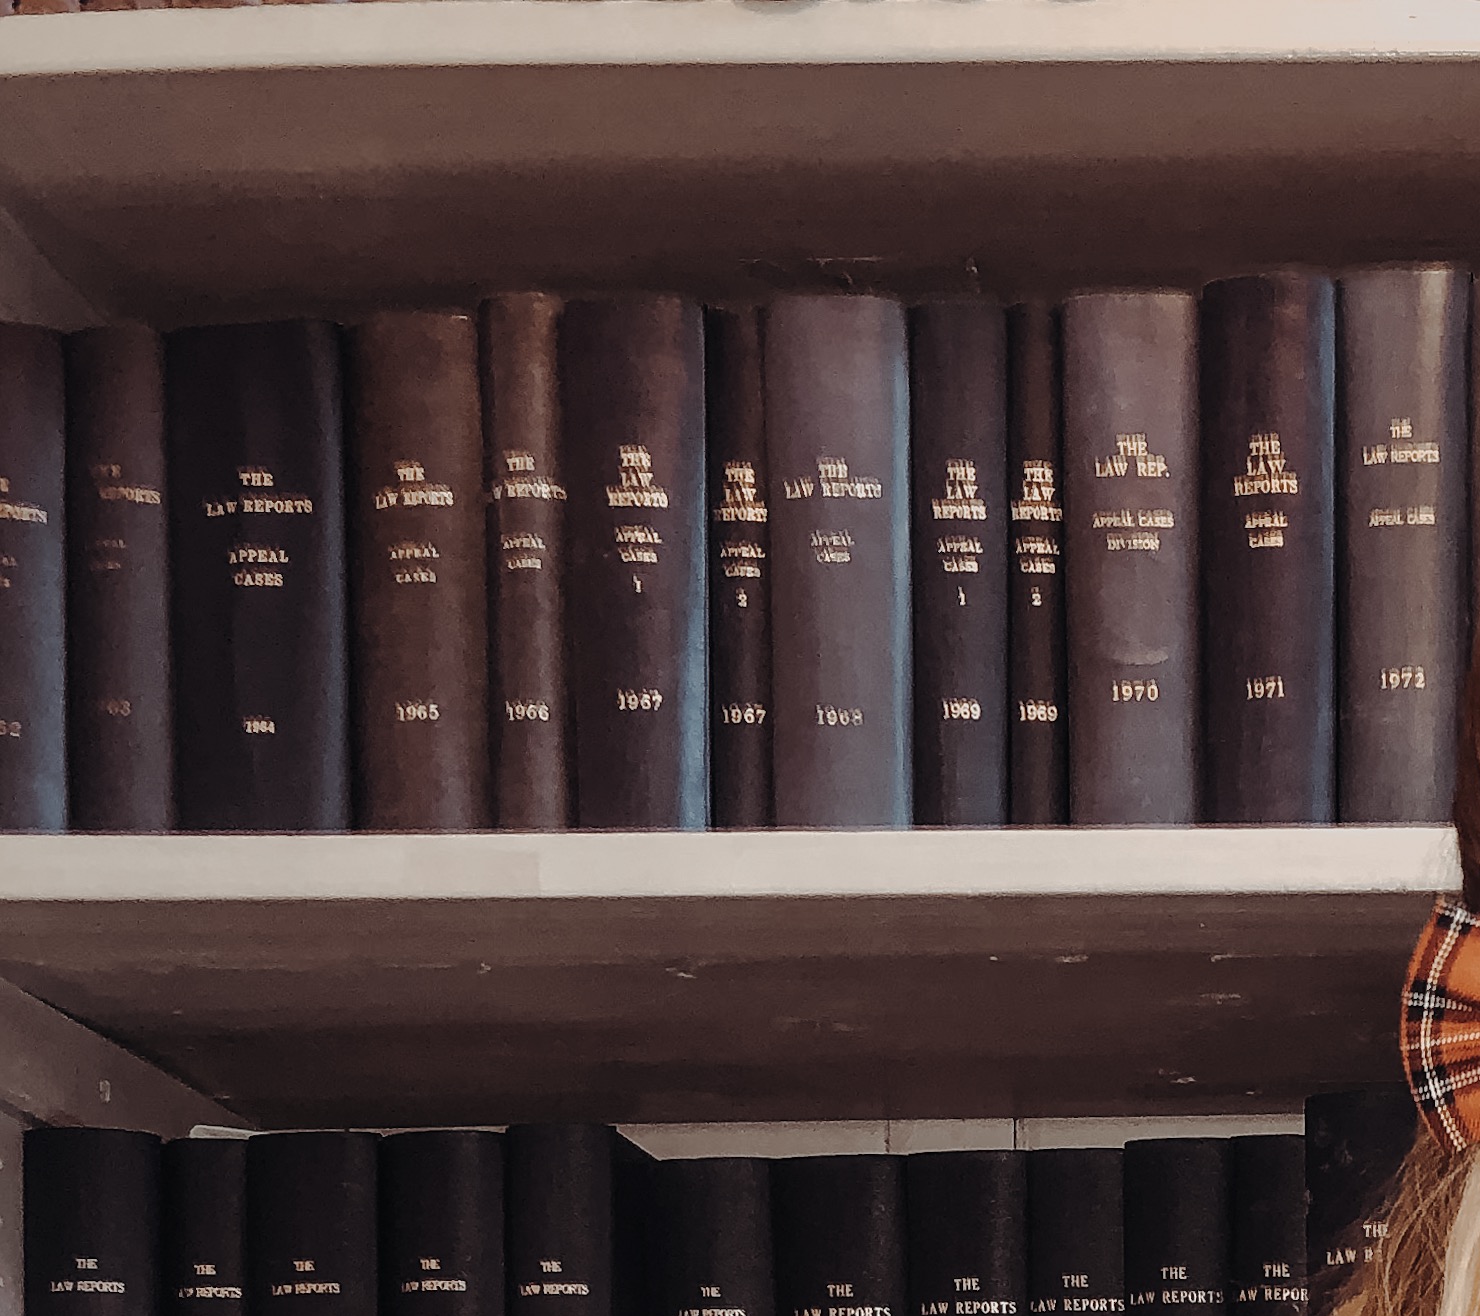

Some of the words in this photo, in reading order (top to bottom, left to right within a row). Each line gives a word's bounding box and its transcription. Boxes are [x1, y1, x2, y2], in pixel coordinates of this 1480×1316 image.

[1117, 440, 1147, 455] THE
[1250, 440, 1281, 456] THE
[1096, 462, 1127, 477] LAW
[1138, 462, 1170, 477] REP.
[1247, 460, 1284, 475] LAW
[240, 471, 273, 487] THE
[948, 484, 976, 500] LAW
[1234, 480, 1297, 495] REPORTS
[207, 501, 238, 517] LAW
[244, 498, 312, 515] REPORTS
[932, 505, 986, 521] REPORTS
[229, 549, 288, 564] APPEAL
[233, 572, 283, 587] CASES
[1032, 590, 1042, 606] 2
[1380, 670, 1425, 690] 1972
[1112, 684, 1159, 702] 1970
[1246, 681, 1285, 699] 1971
[397, 703, 439, 721] 1965
[506, 704, 549, 721] 1966
[723, 707, 766, 725] 1967
[943, 702, 981, 719] 1969
[1020, 704, 1058, 722] 1969
[76, 1259, 98, 1269] THE
[1161, 1268, 1188, 1280] THE
[1264, 1266, 1290, 1278] THE
[51, 1281, 73, 1292] LAW
[78, 1281, 124, 1294] REPORTS
[954, 1279, 980, 1291] THE
[1062, 1276, 1088, 1288] THE
[827, 1284, 854, 1297] THE
[921, 1302, 948, 1315] LAW
[954, 1302, 1016, 1315] REPORTS
